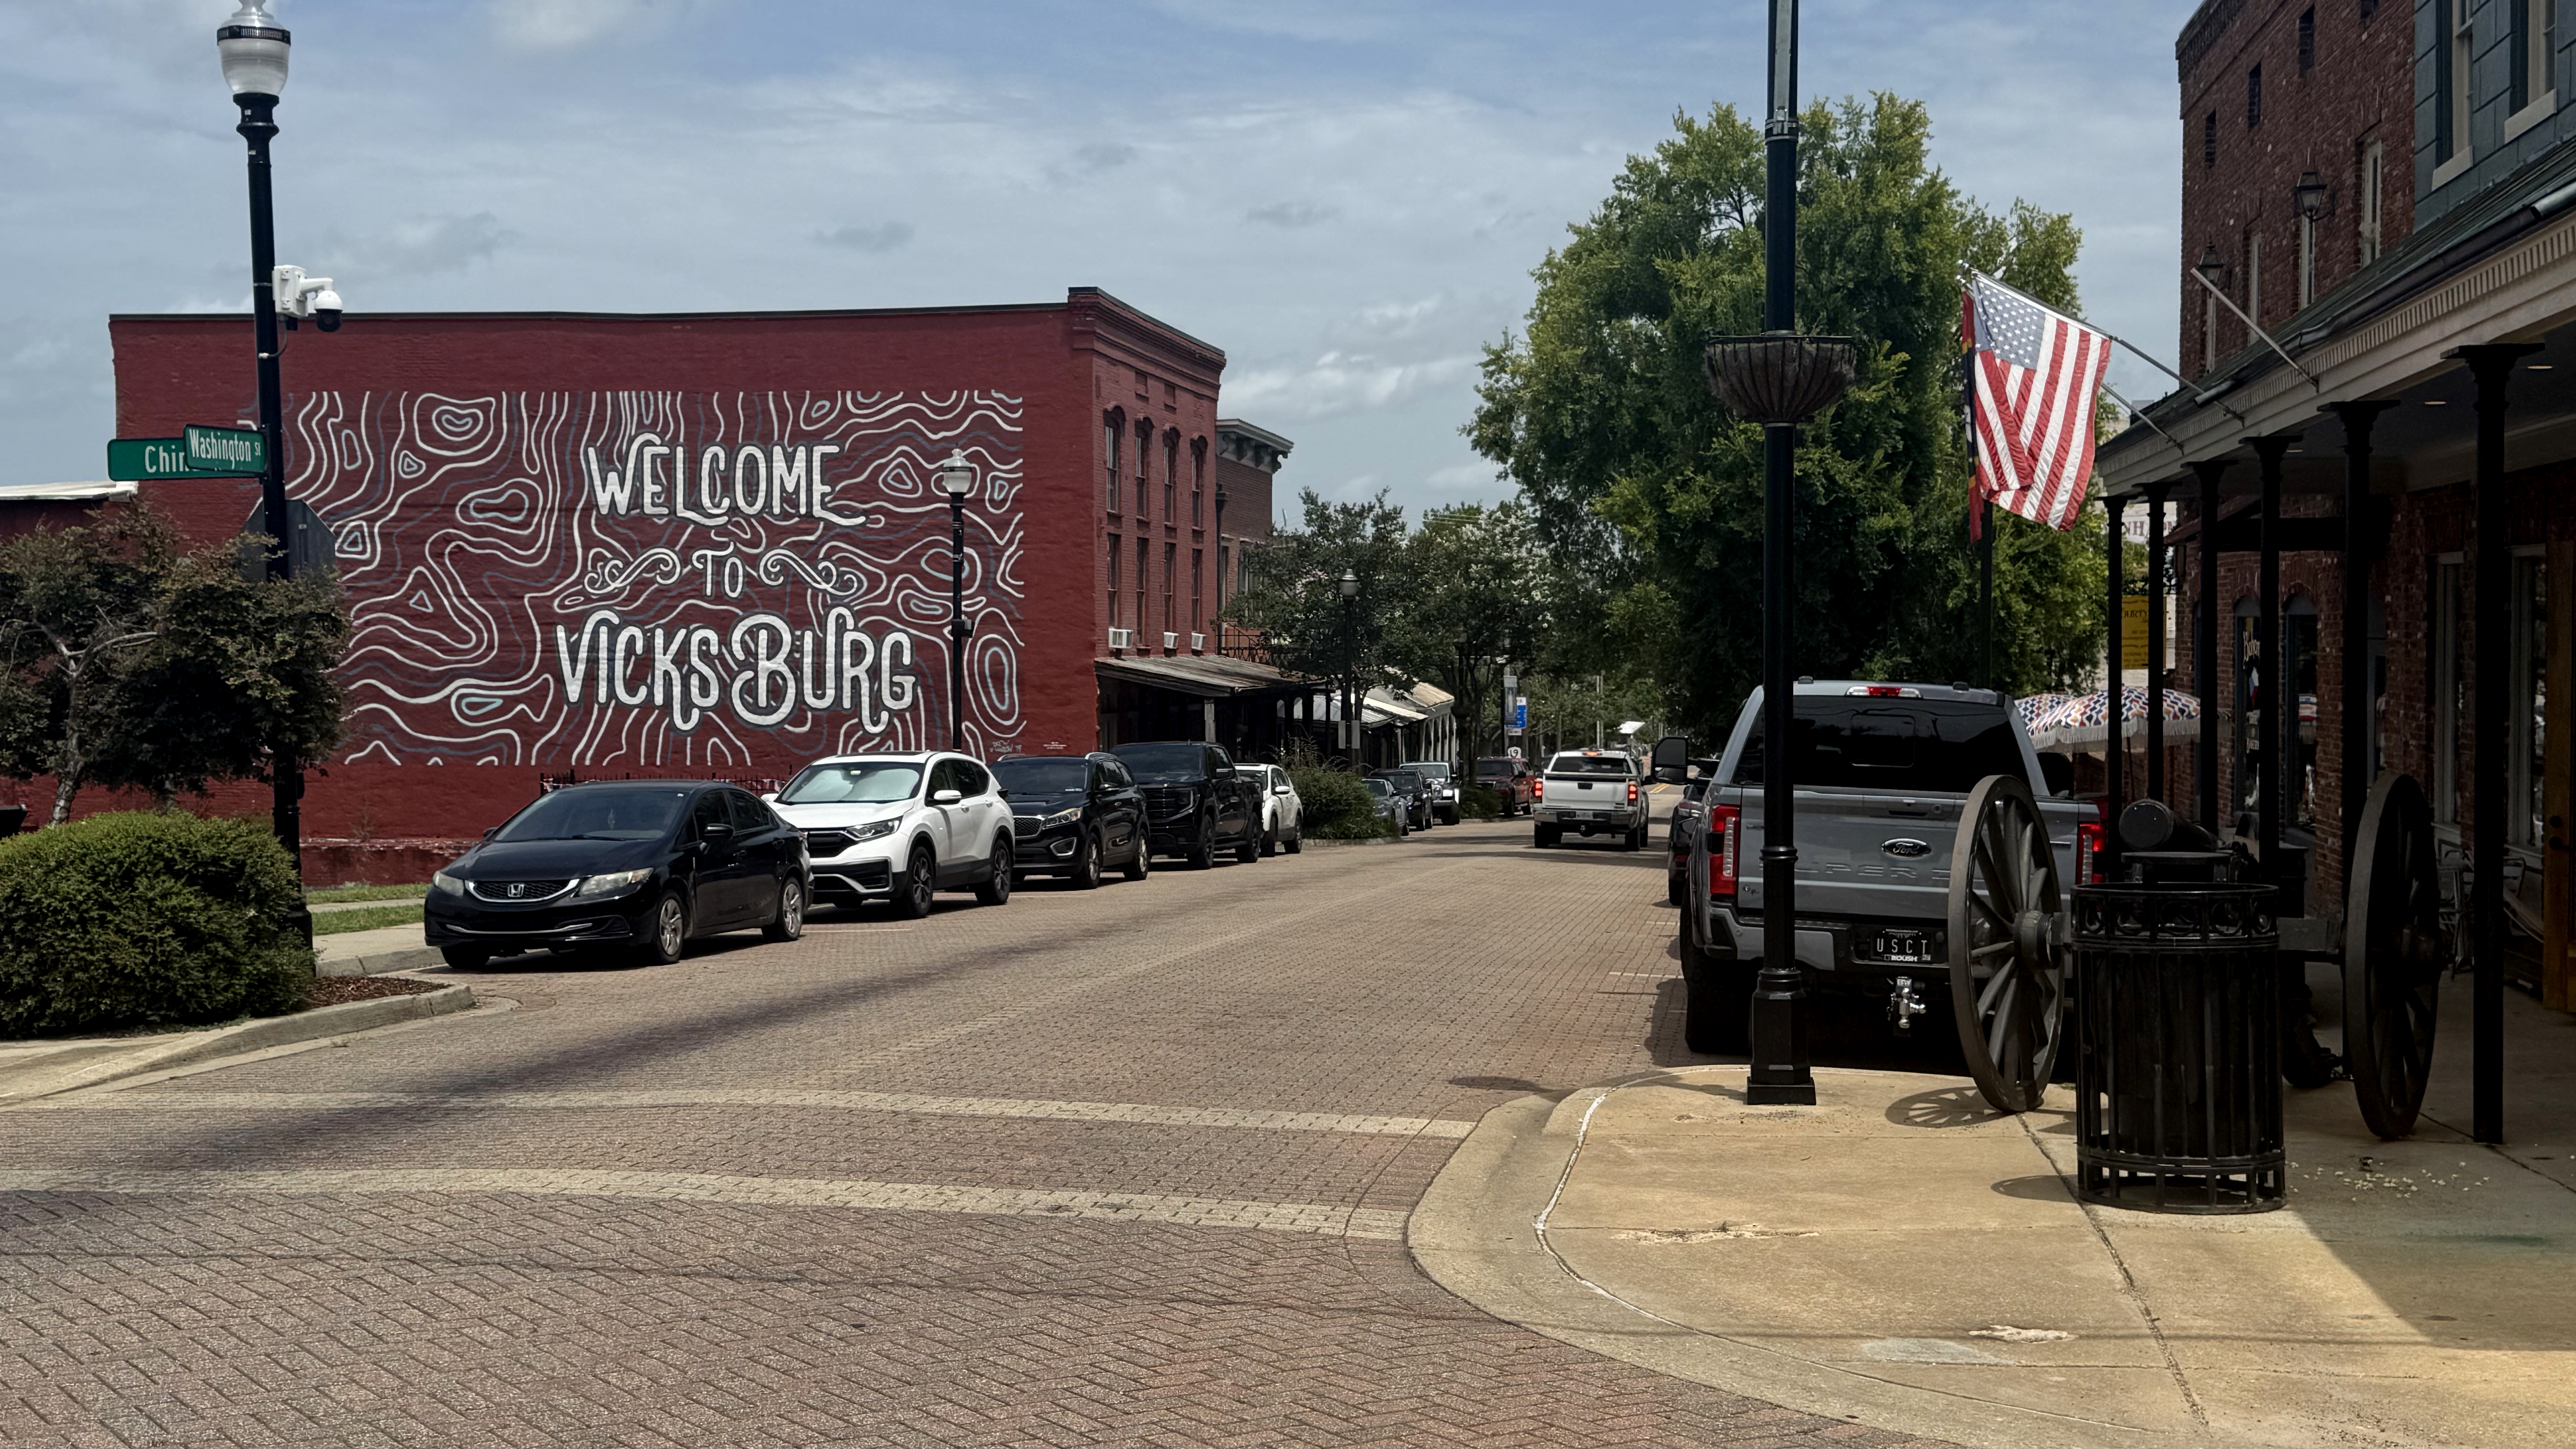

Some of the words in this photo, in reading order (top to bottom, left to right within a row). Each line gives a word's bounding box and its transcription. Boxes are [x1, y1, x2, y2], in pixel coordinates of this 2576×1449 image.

[145, 445, 200, 473] Chin
[189, 429, 251, 469] Washington
[587, 432, 866, 526] WELCOME
[692, 541, 744, 598] TO
[556, 605, 916, 734] VICKSBURG
[1893, 842, 1920, 854] Ford
[1759, 862, 1917, 879] UPER
[1877, 938, 1928, 955] USCT
